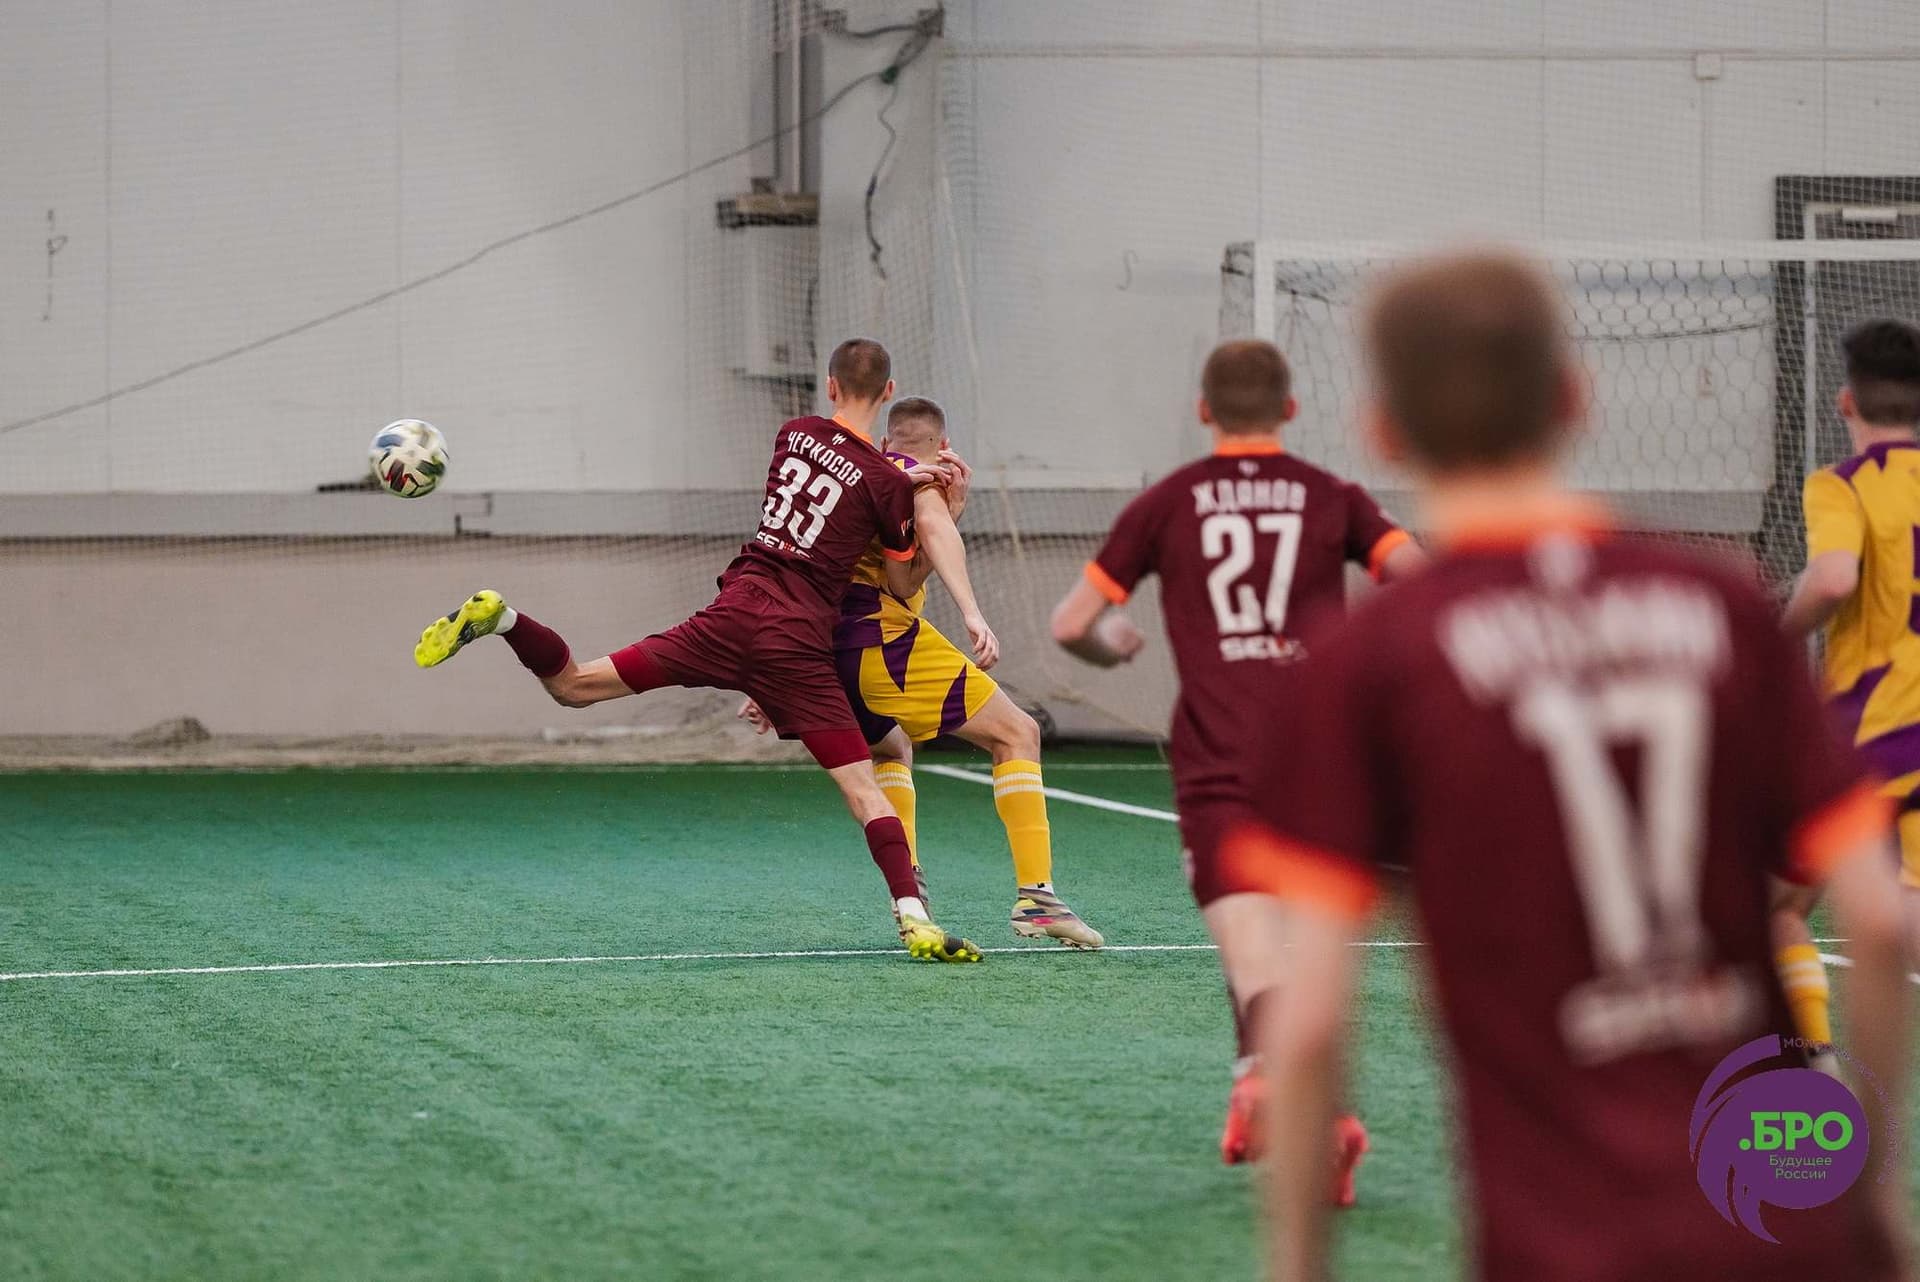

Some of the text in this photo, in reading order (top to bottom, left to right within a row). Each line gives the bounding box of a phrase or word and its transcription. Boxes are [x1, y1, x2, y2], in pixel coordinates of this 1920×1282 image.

[762, 456, 844, 549] 33
[787, 431, 863, 487] ЧЕРКАСОВ
[1201, 512, 1303, 634] 27
